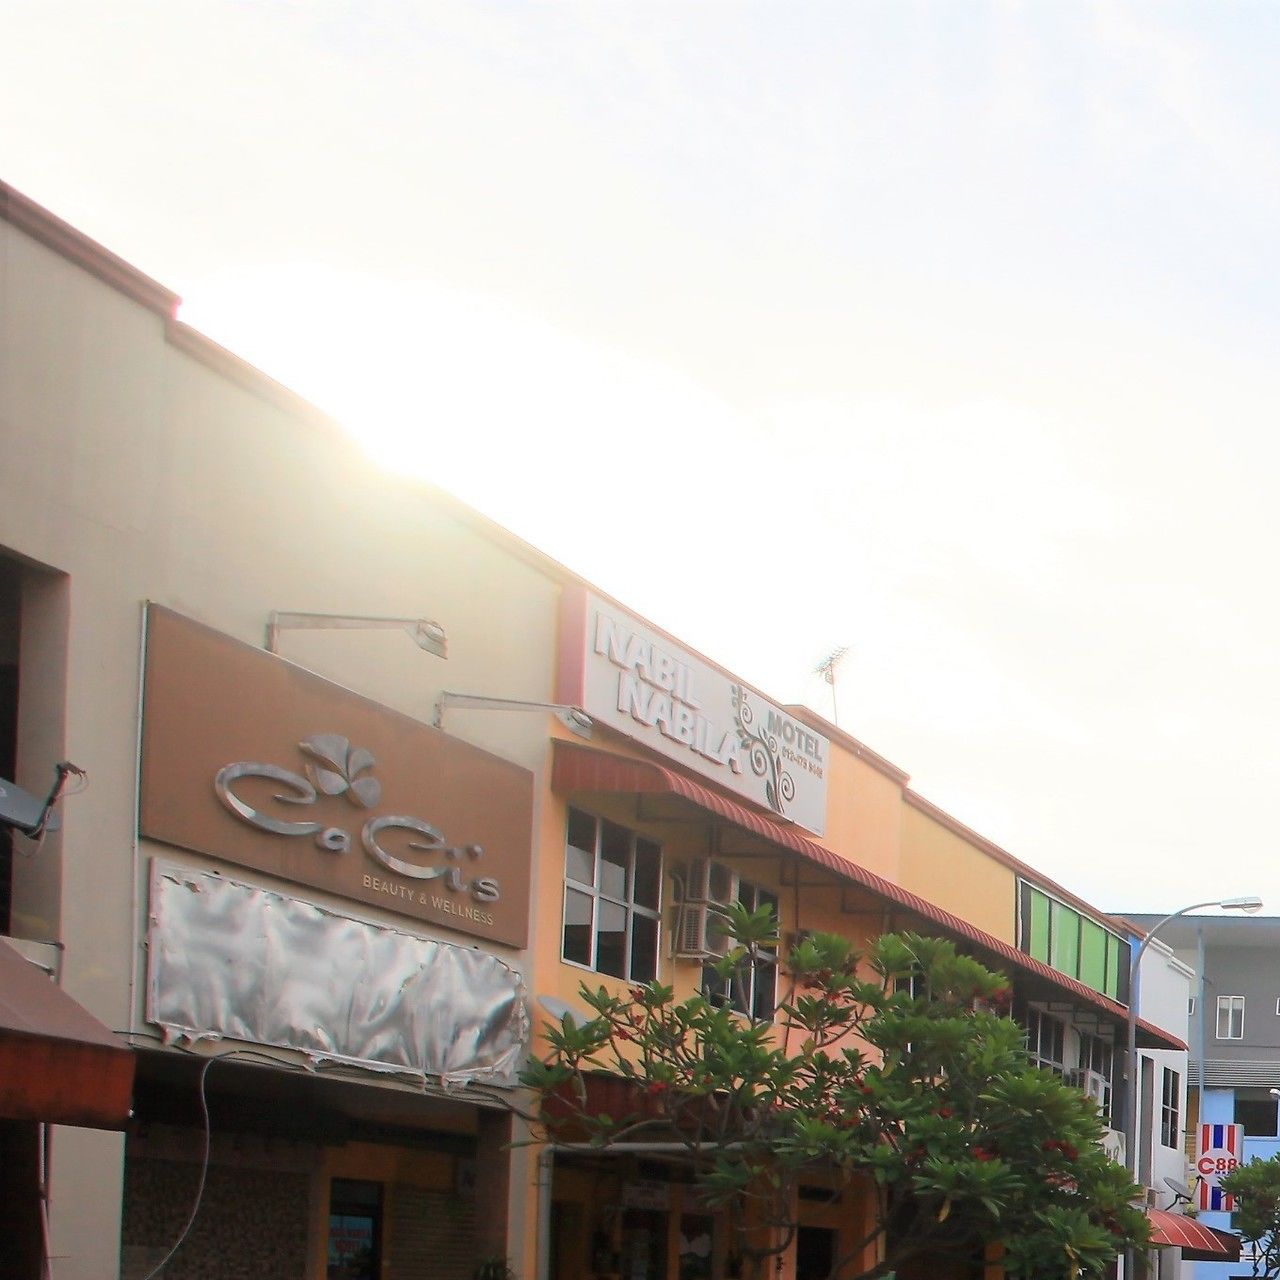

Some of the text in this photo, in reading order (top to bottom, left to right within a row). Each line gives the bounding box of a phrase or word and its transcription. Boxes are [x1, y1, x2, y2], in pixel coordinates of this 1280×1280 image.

[595, 610, 702, 710] NABIL
[616, 671, 743, 776] NABILA
[767, 709, 823, 762] MOTEL
[361, 873, 495, 926] BEAUTY & WELLNESS
